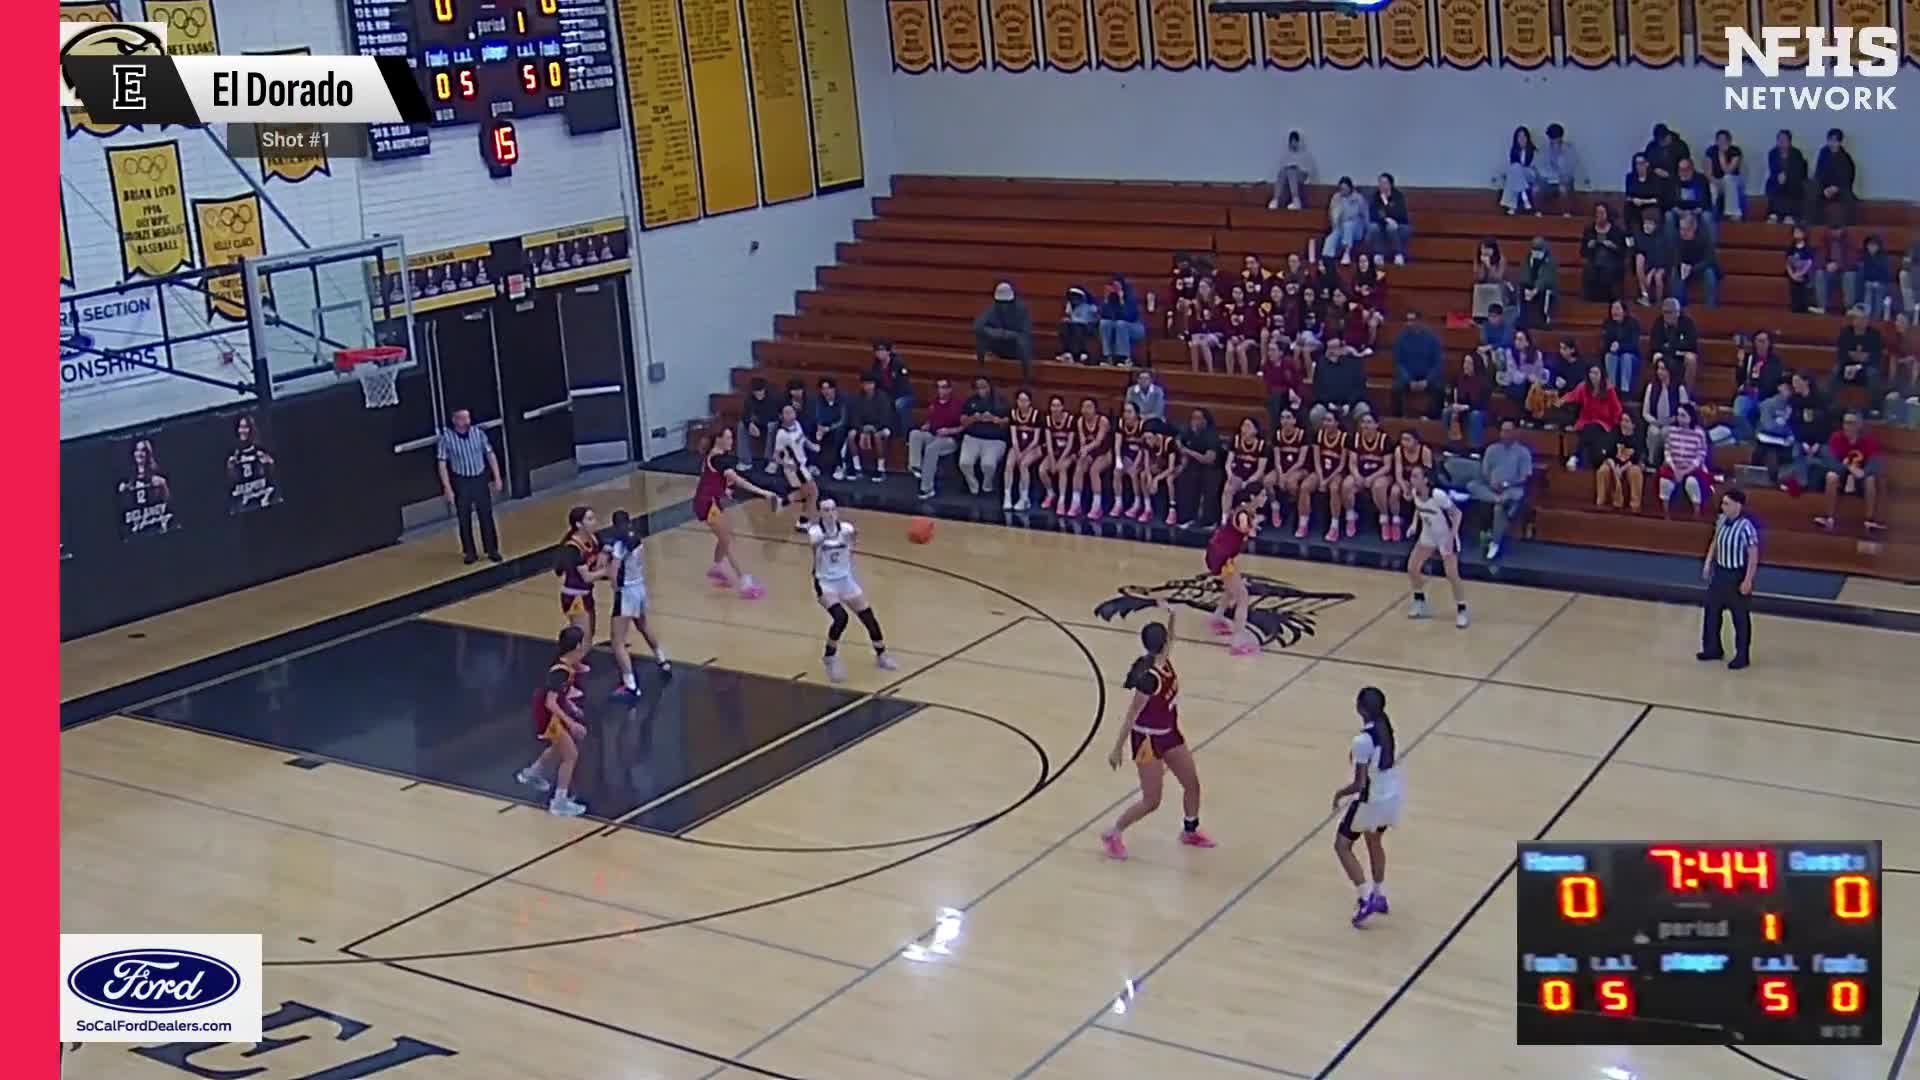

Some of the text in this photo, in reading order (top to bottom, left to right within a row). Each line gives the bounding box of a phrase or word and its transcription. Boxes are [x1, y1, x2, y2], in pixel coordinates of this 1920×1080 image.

[436, 61, 561, 100] 0 5 5 0
[494, 126, 516, 160] 15
[123, 189, 151, 201] BRIAN
[137, 240, 178, 255] BASEBALL
[83, 297, 151, 322] SECTION
